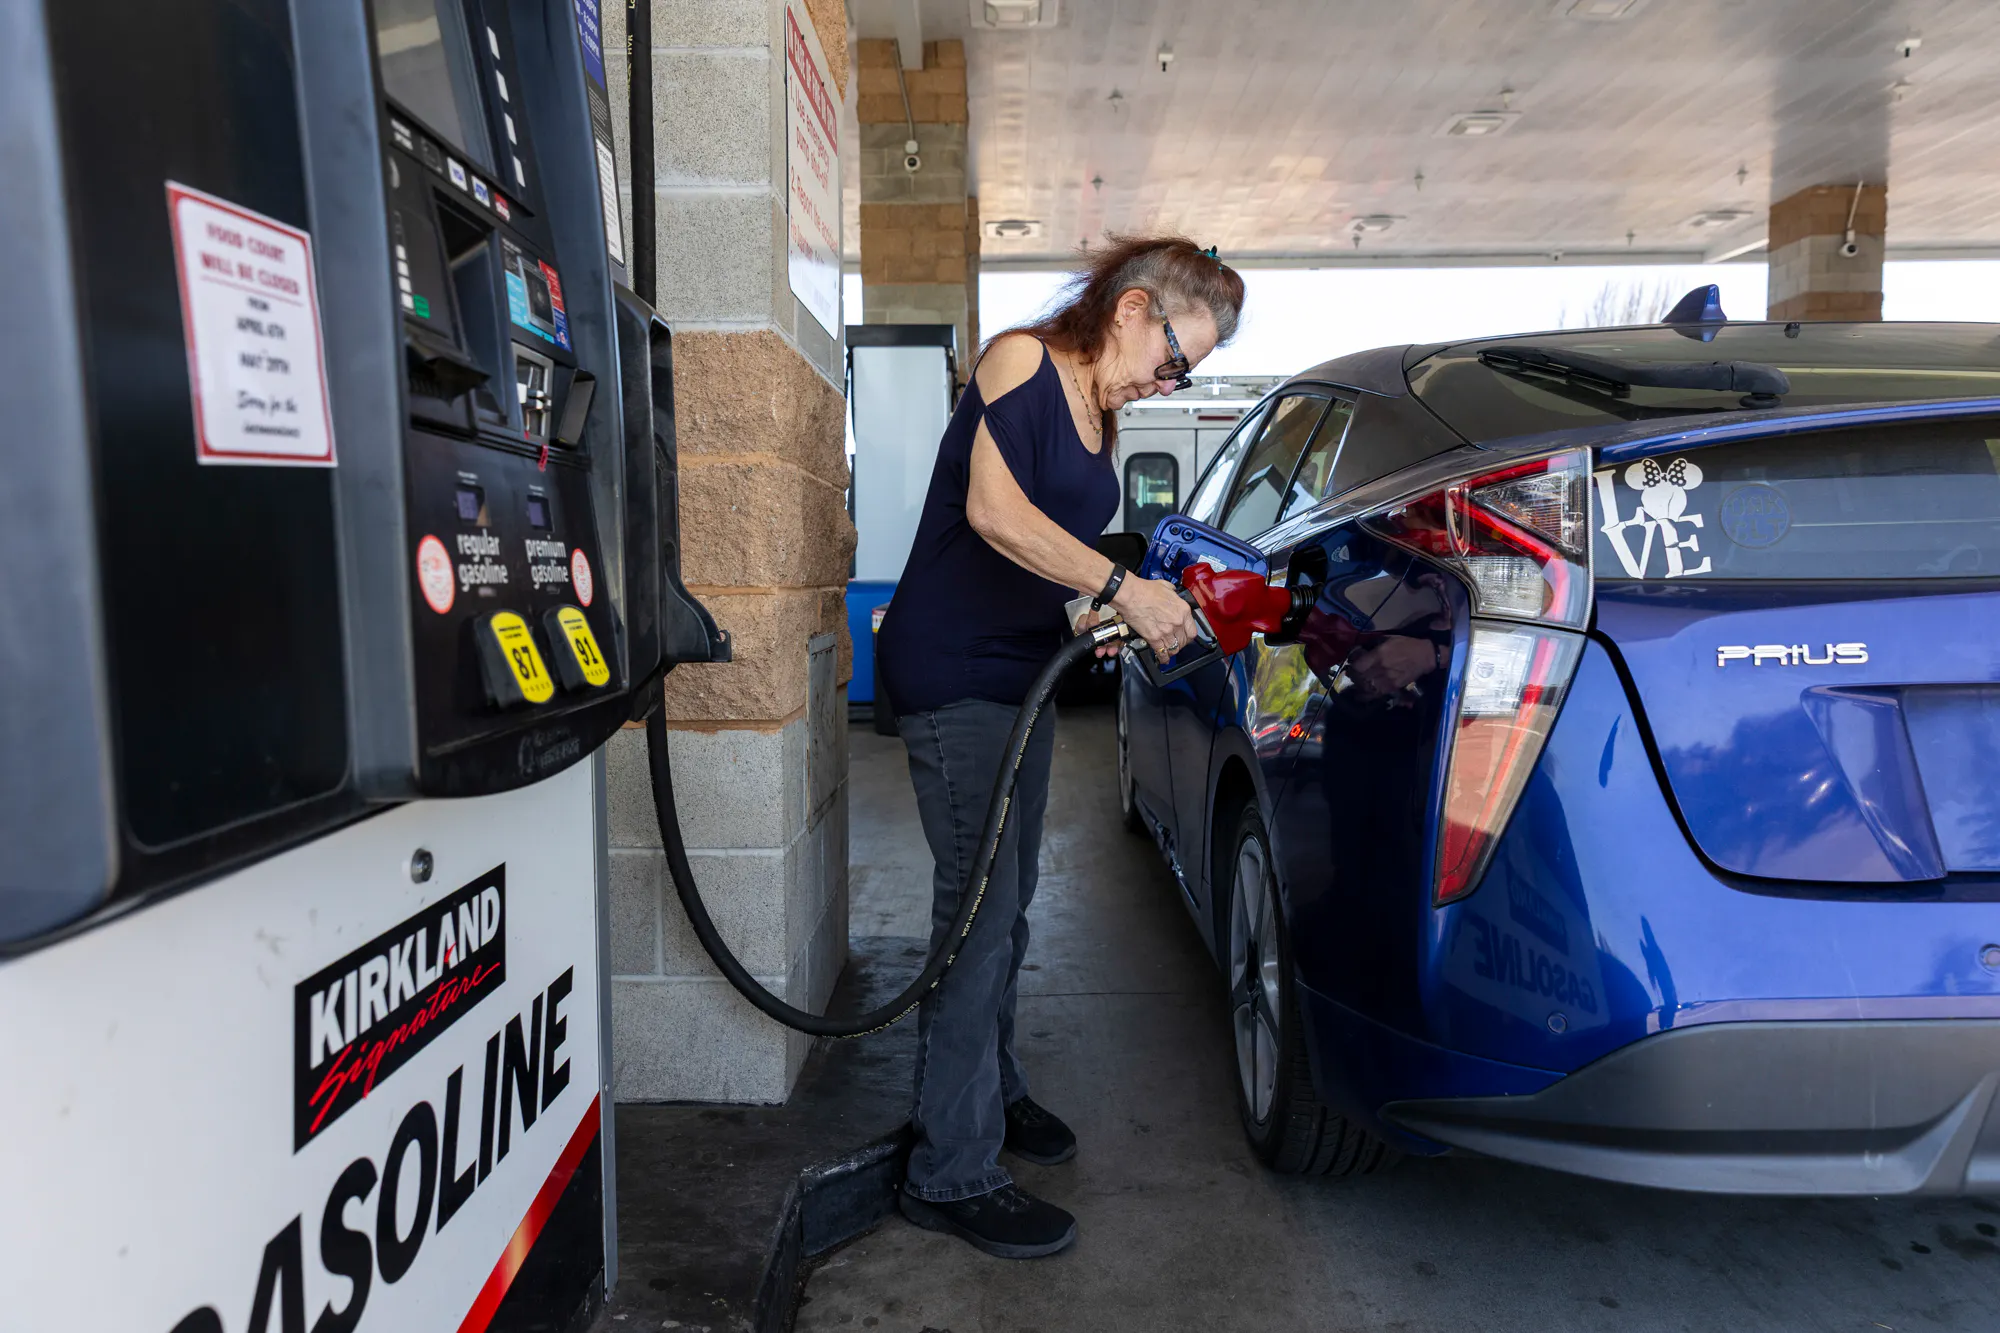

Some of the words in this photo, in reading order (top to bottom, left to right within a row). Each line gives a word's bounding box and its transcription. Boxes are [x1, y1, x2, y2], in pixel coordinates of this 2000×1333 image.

[795, 85, 806, 123] Use
[805, 114, 830, 171] emergency
[796, 125, 810, 164] pump
[257, 268, 300, 296] CLOSED
[456, 528, 501, 562] regular
[524, 535, 567, 563] premium
[458, 557, 509, 592] gasoline
[530, 559, 569, 590] gasoline
[512, 645, 538, 680] 87
[574, 636, 599, 667] 91
[1716, 642, 1869, 668] PRIUS
[971, 896, 982, 914] Made
[309, 885, 500, 1069] KIRKLAND
[310, 962, 500, 1134] Signature
[166, 965, 574, 1333] ASOLINE
